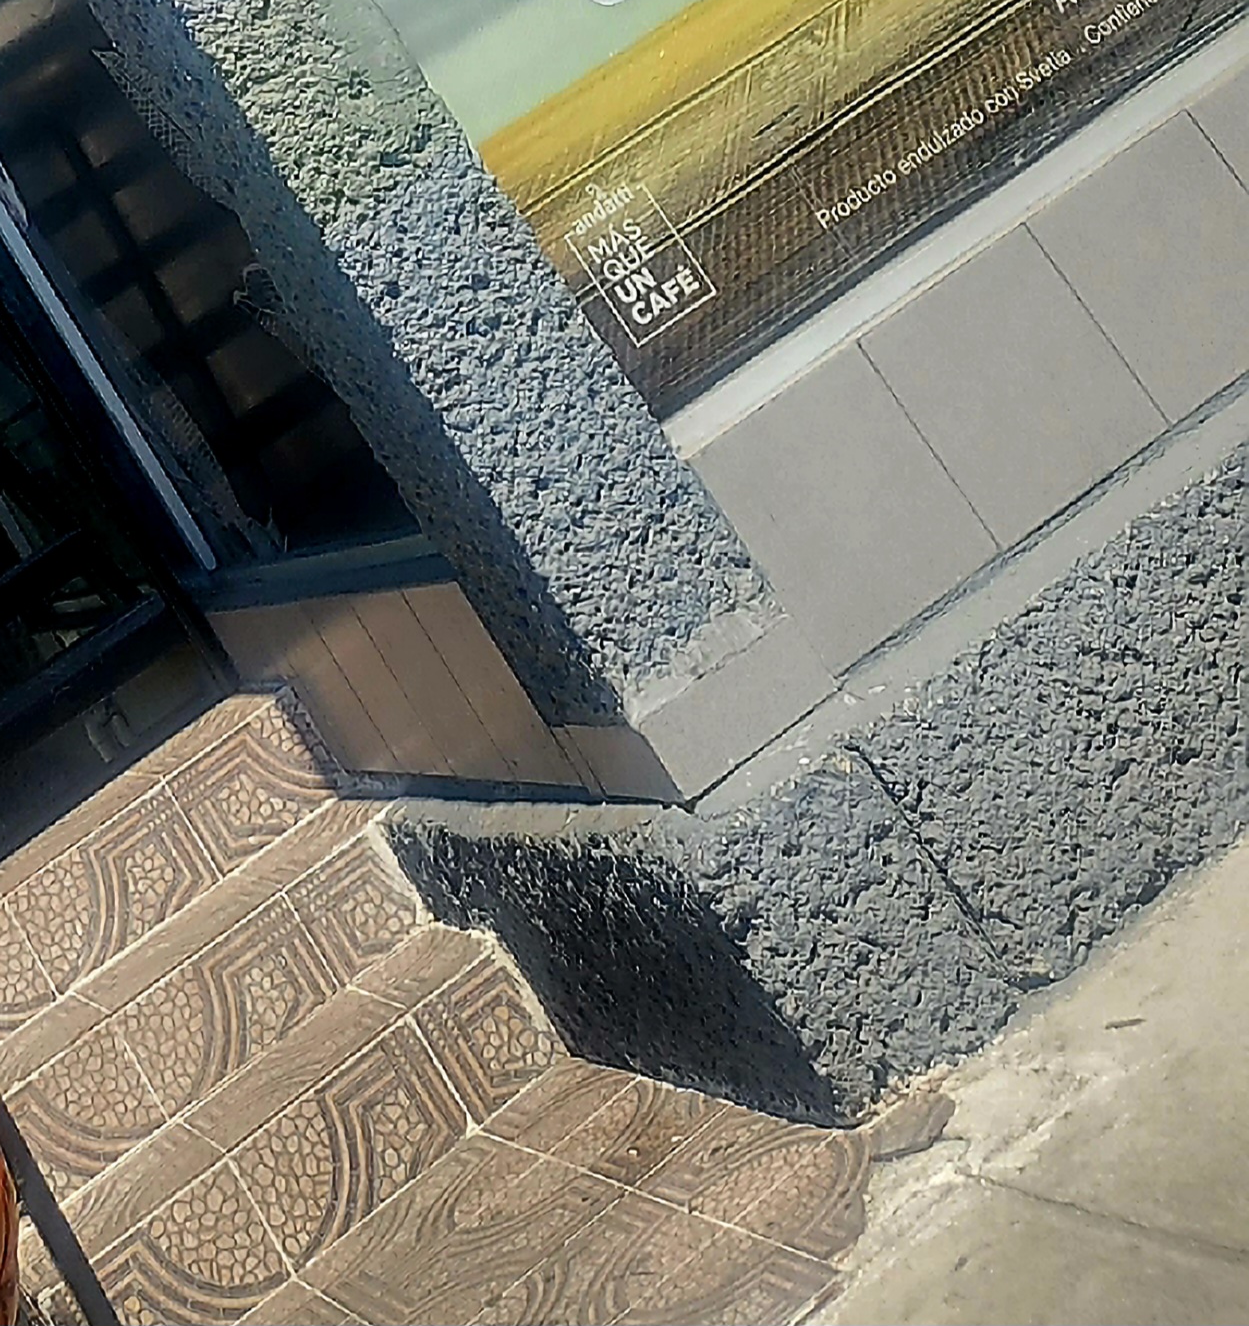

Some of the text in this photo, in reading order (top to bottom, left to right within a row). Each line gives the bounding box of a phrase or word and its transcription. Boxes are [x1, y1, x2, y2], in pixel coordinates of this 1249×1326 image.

[816, 167, 898, 230] Producto
[897, 108, 985, 174] endulzado
[984, 85, 1020, 116] con
[613, 266, 658, 304] UN
[631, 264, 700, 325] CAFÉ
